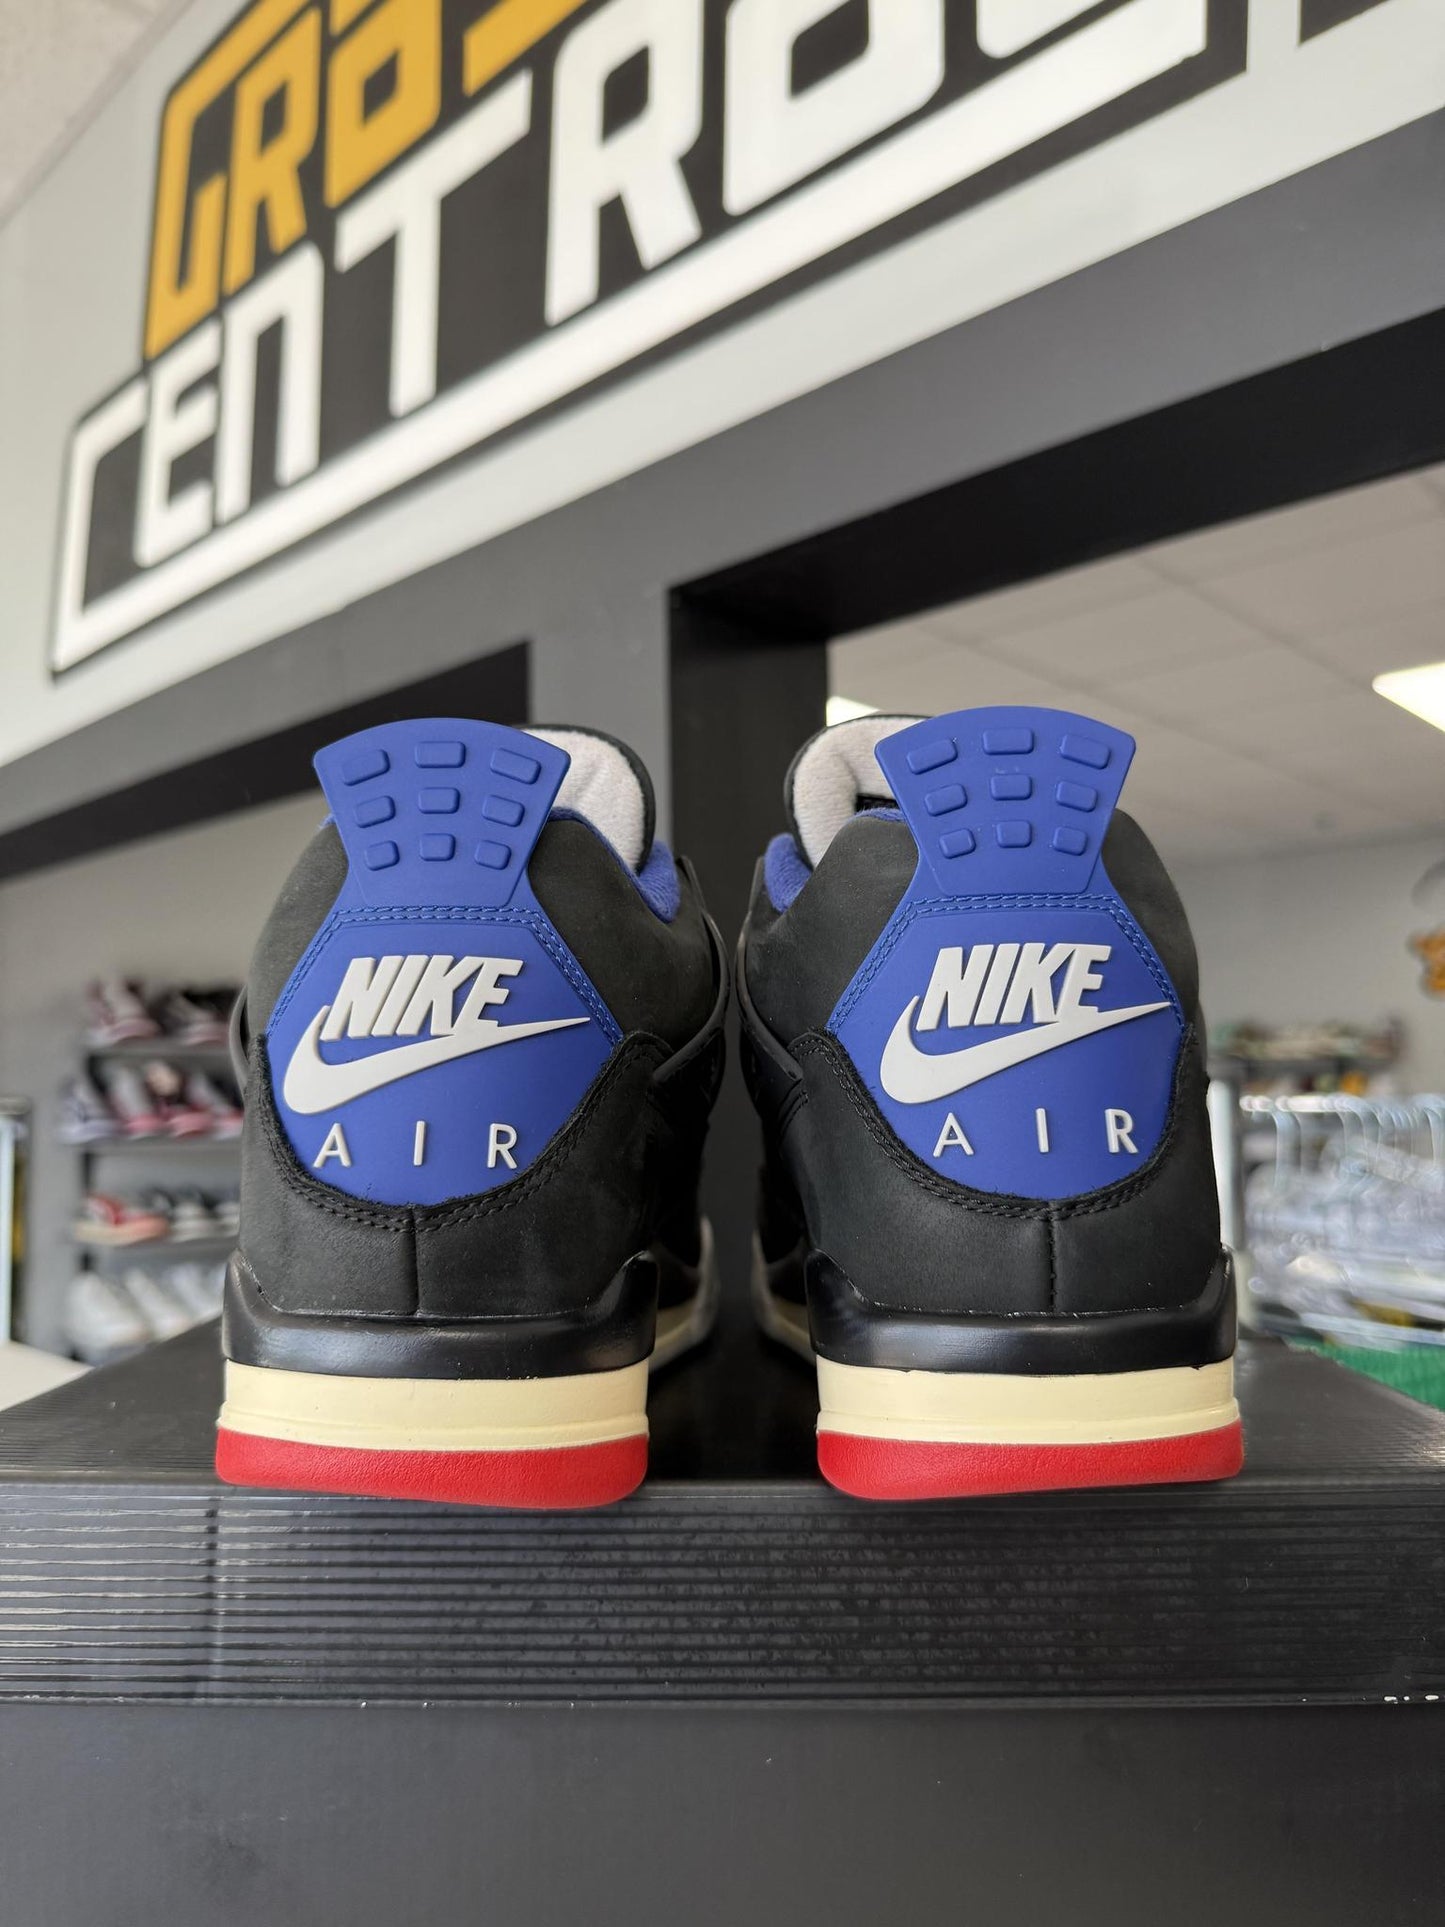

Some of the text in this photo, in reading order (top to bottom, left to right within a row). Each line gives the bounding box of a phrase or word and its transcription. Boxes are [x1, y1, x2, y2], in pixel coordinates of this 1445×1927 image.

[319, 955, 524, 1042] NIKE
[915, 942, 1112, 1031] NIKE
[312, 1120, 518, 1169] AIR
[932, 1107, 1139, 1158] AIR
